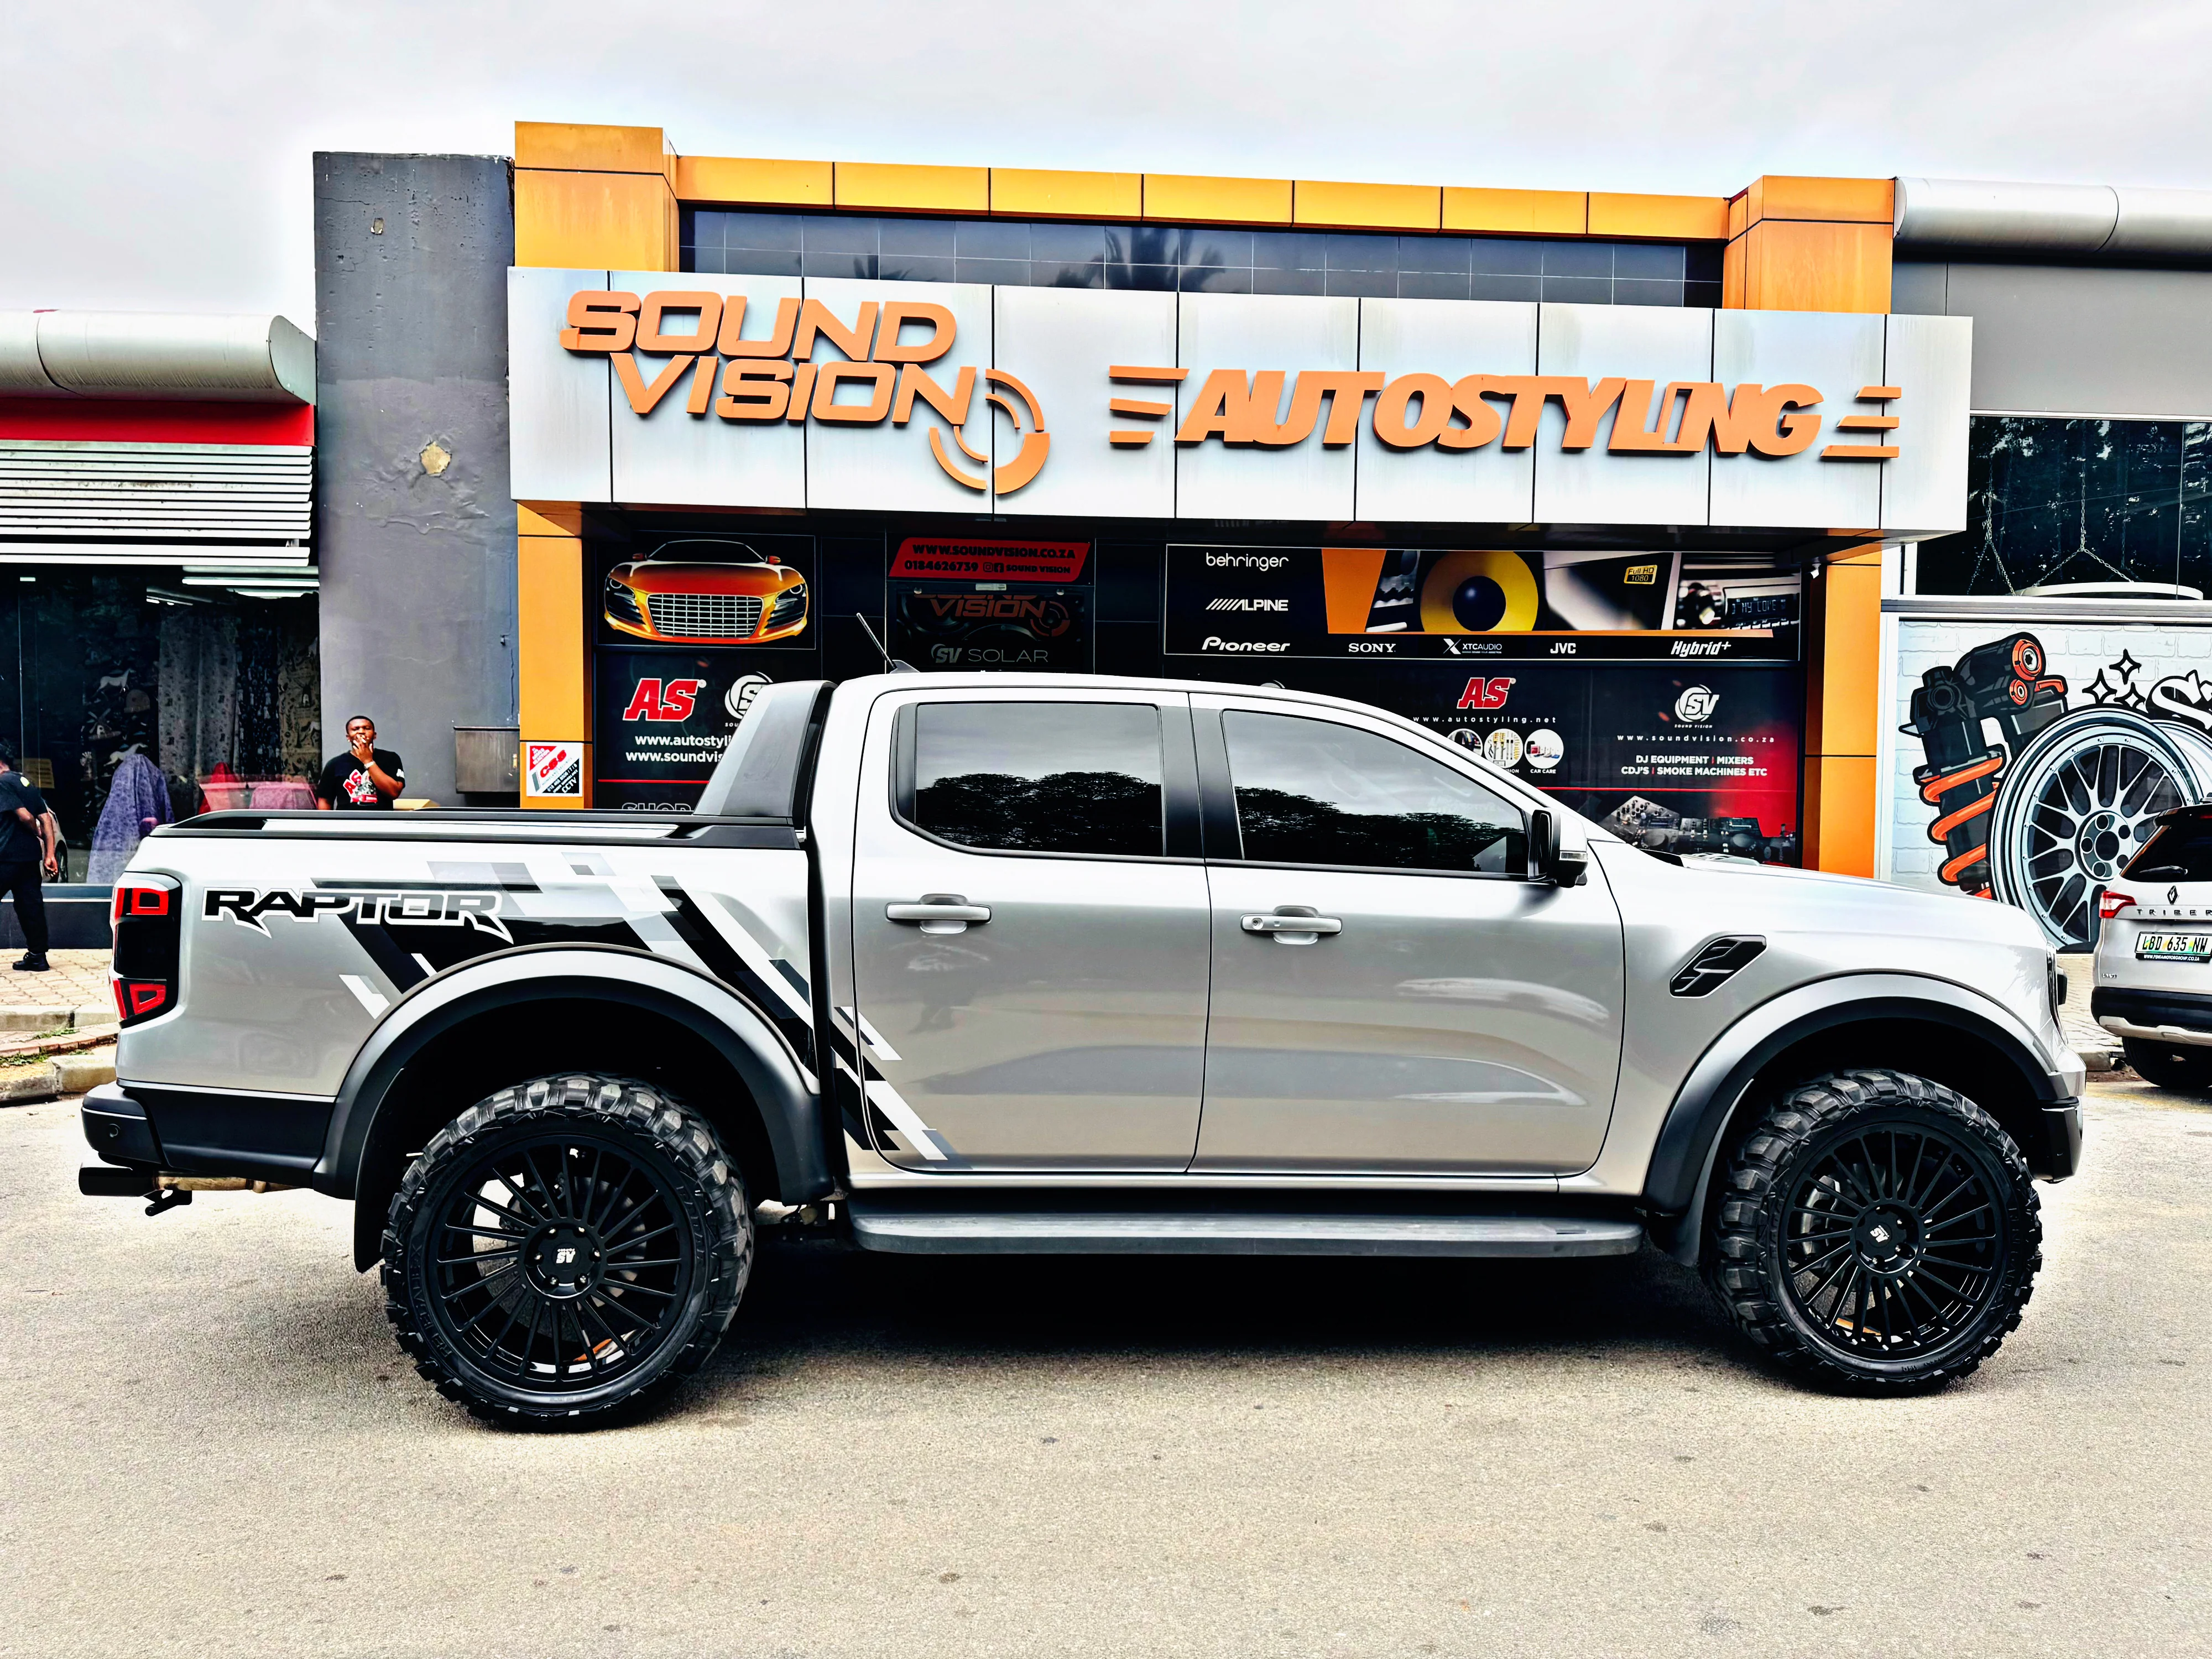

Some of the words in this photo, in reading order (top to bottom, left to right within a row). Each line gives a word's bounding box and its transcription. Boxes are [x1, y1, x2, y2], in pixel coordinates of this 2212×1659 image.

[559, 290, 957, 363] SOUND
[609, 353, 977, 425] VISION
[1173, 368, 1824, 457] AUTOSTYLING
[912, 544, 1076, 559] WWW.SOUNDVISION.CO.ZA
[904, 560, 979, 572] 0184626739
[1006, 564, 1037, 572] SOUND
[1039, 565, 1071, 574] VISION
[1206, 552, 1289, 572] behringer
[930, 599, 1046, 618] VISION
[1230, 599, 1288, 611] ALPINE
[1202, 636, 1290, 652] Pioneer
[1348, 643, 1396, 653] SONY
[1550, 643, 1576, 654] JVC
[1671, 640, 1731, 658] Hybrid+
[968, 649, 1048, 662] SOLAR
[622, 677, 700, 722] AS
[1457, 677, 1511, 709] AS
[635, 735, 732, 749] www.autostyli
[1617, 734, 1775, 743] www.soundvision.co.za
[625, 751, 723, 763] www.soundvis
[1636, 755, 1648, 764] DJ
[1650, 755, 1709, 764] EQUIPMENT
[1717, 756, 1754, 765] MIXERS
[1621, 766, 1649, 775] CDJ'S
[1657, 766, 1693, 775] SMOKE
[1694, 767, 1746, 776] MACHINES
[1748, 768, 1767, 776] ETC
[561, 776, 577, 793] CCTV
[201, 886, 514, 945] RAPTOR
[2142, 936, 2163, 951] LBD
[2167, 936, 2188, 951] 635
[2192, 937, 2208, 952] NW
